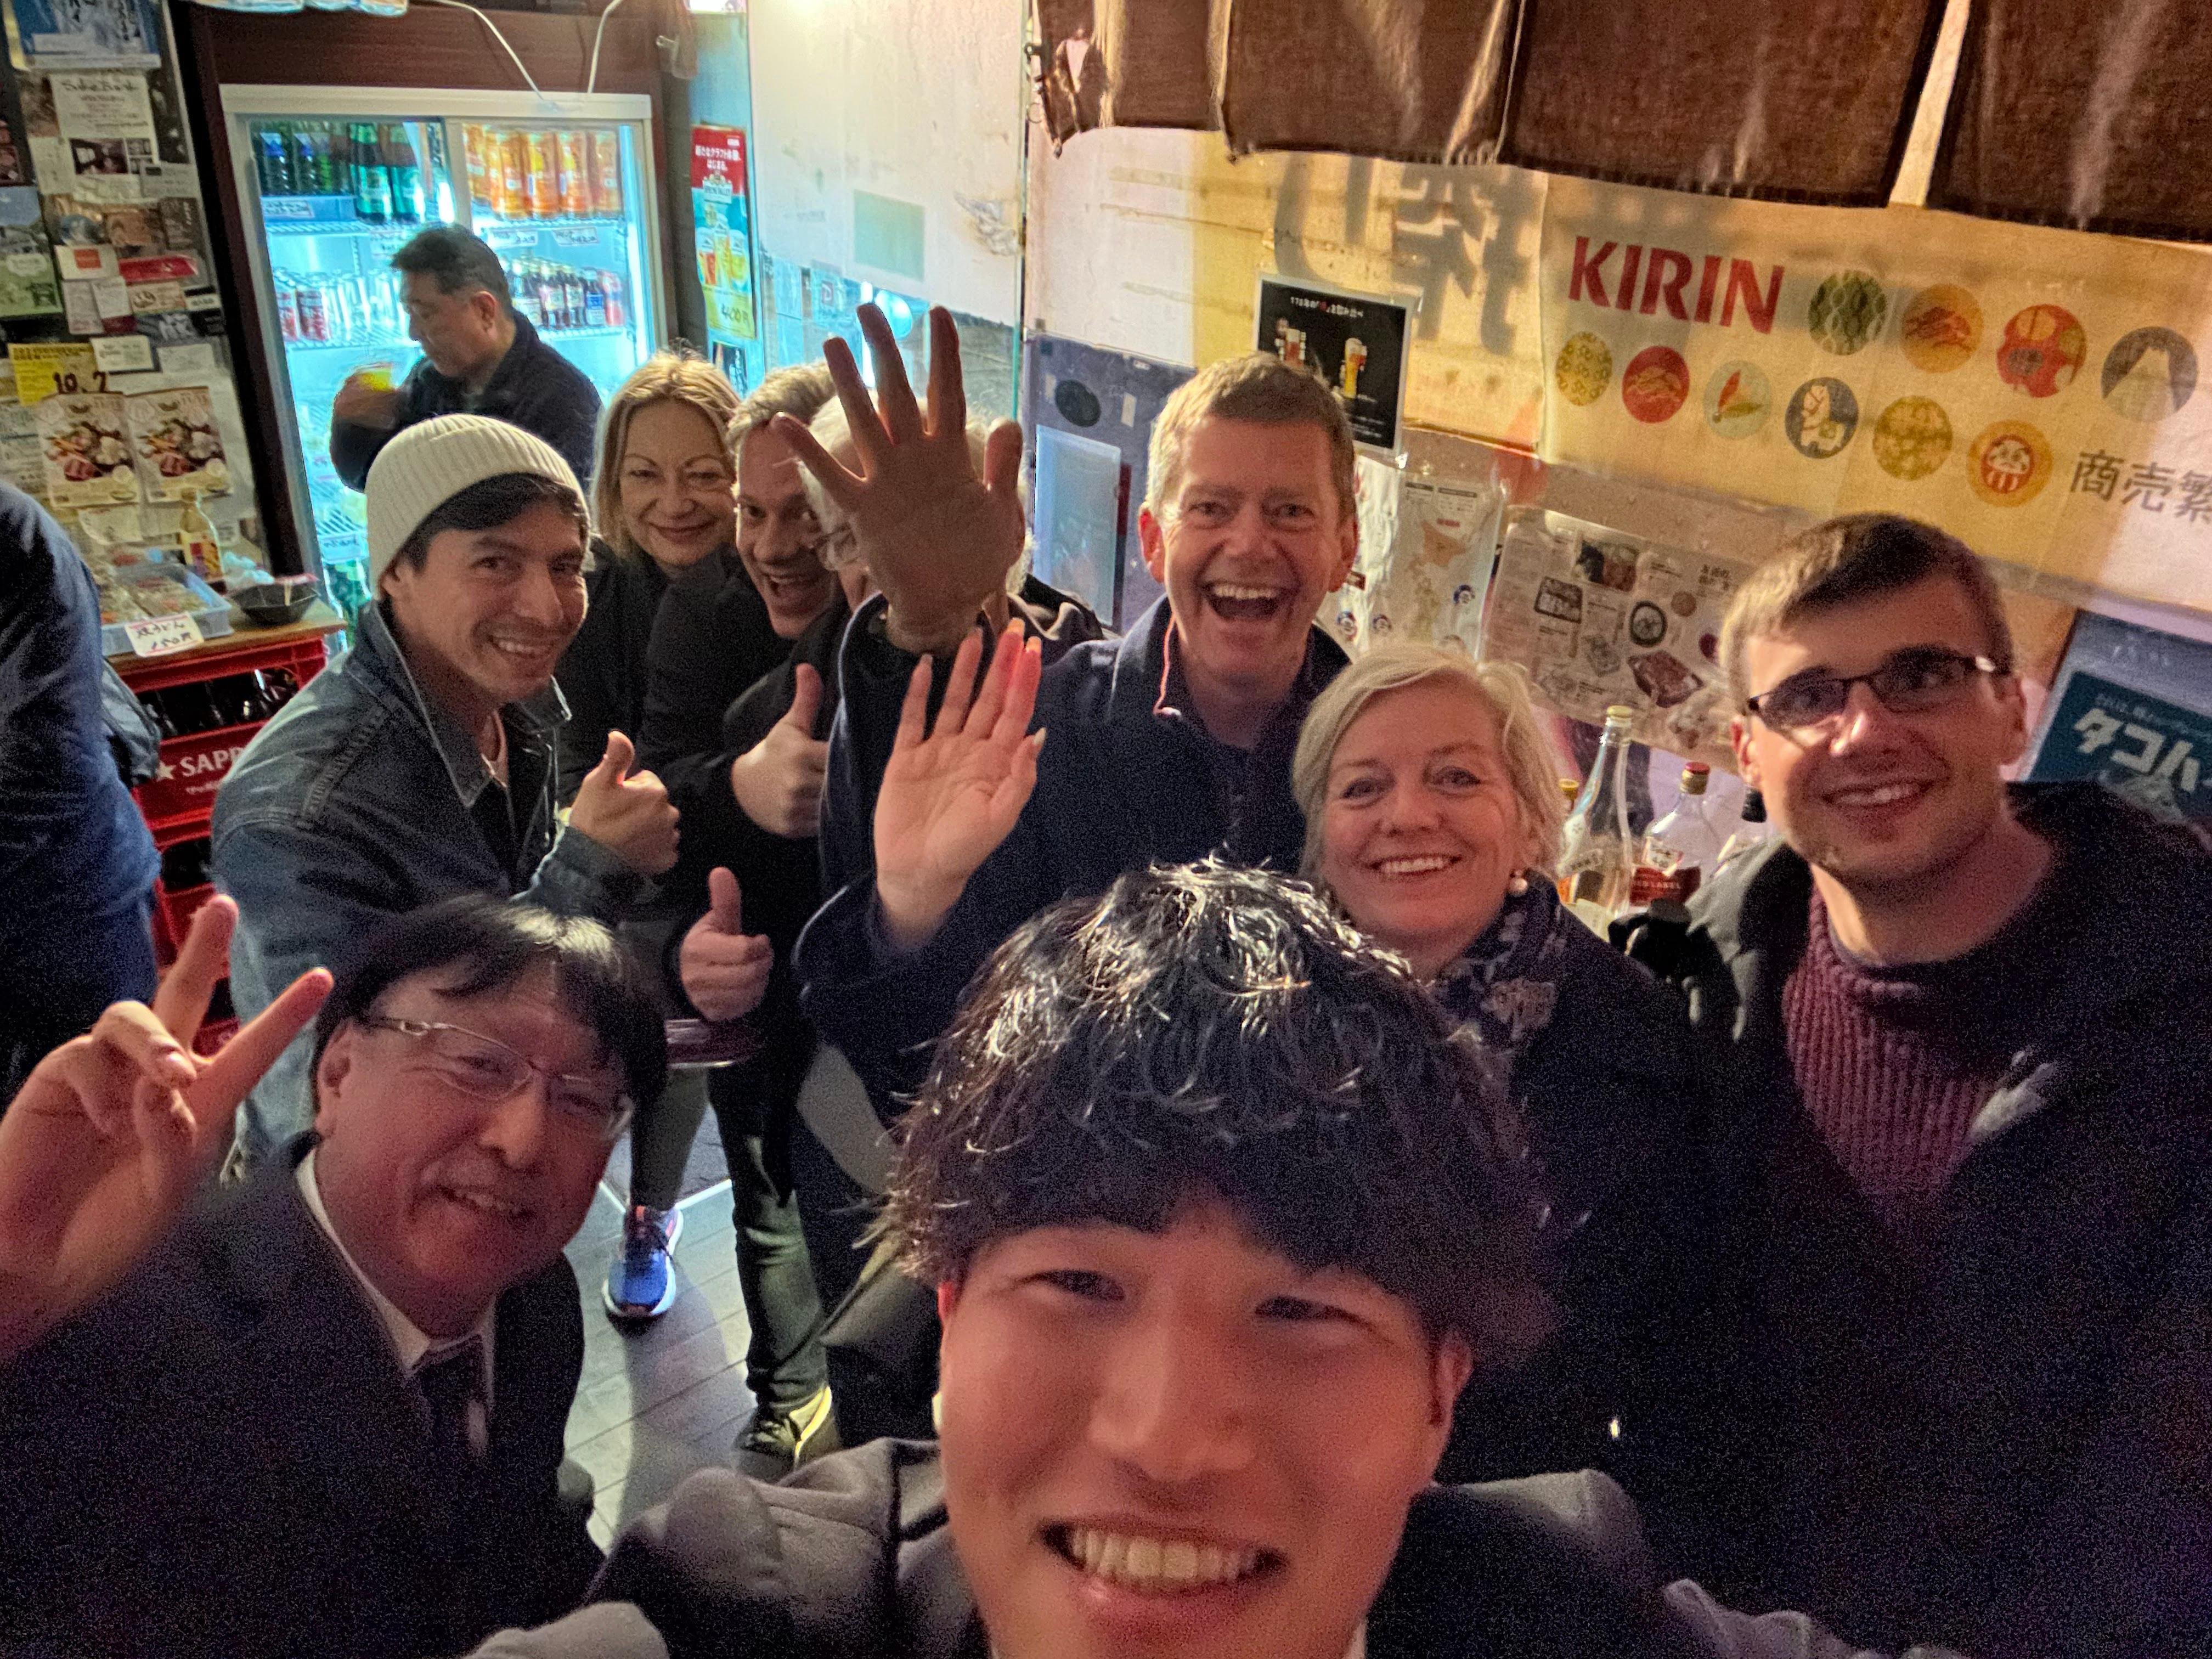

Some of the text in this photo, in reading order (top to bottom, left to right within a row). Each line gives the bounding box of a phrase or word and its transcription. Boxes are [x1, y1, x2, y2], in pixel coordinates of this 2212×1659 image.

[1568, 236, 1785, 334] KIRIN
[2070, 449, 2212, 524] 商売繁
[2073, 707, 2212, 792] タコハ
